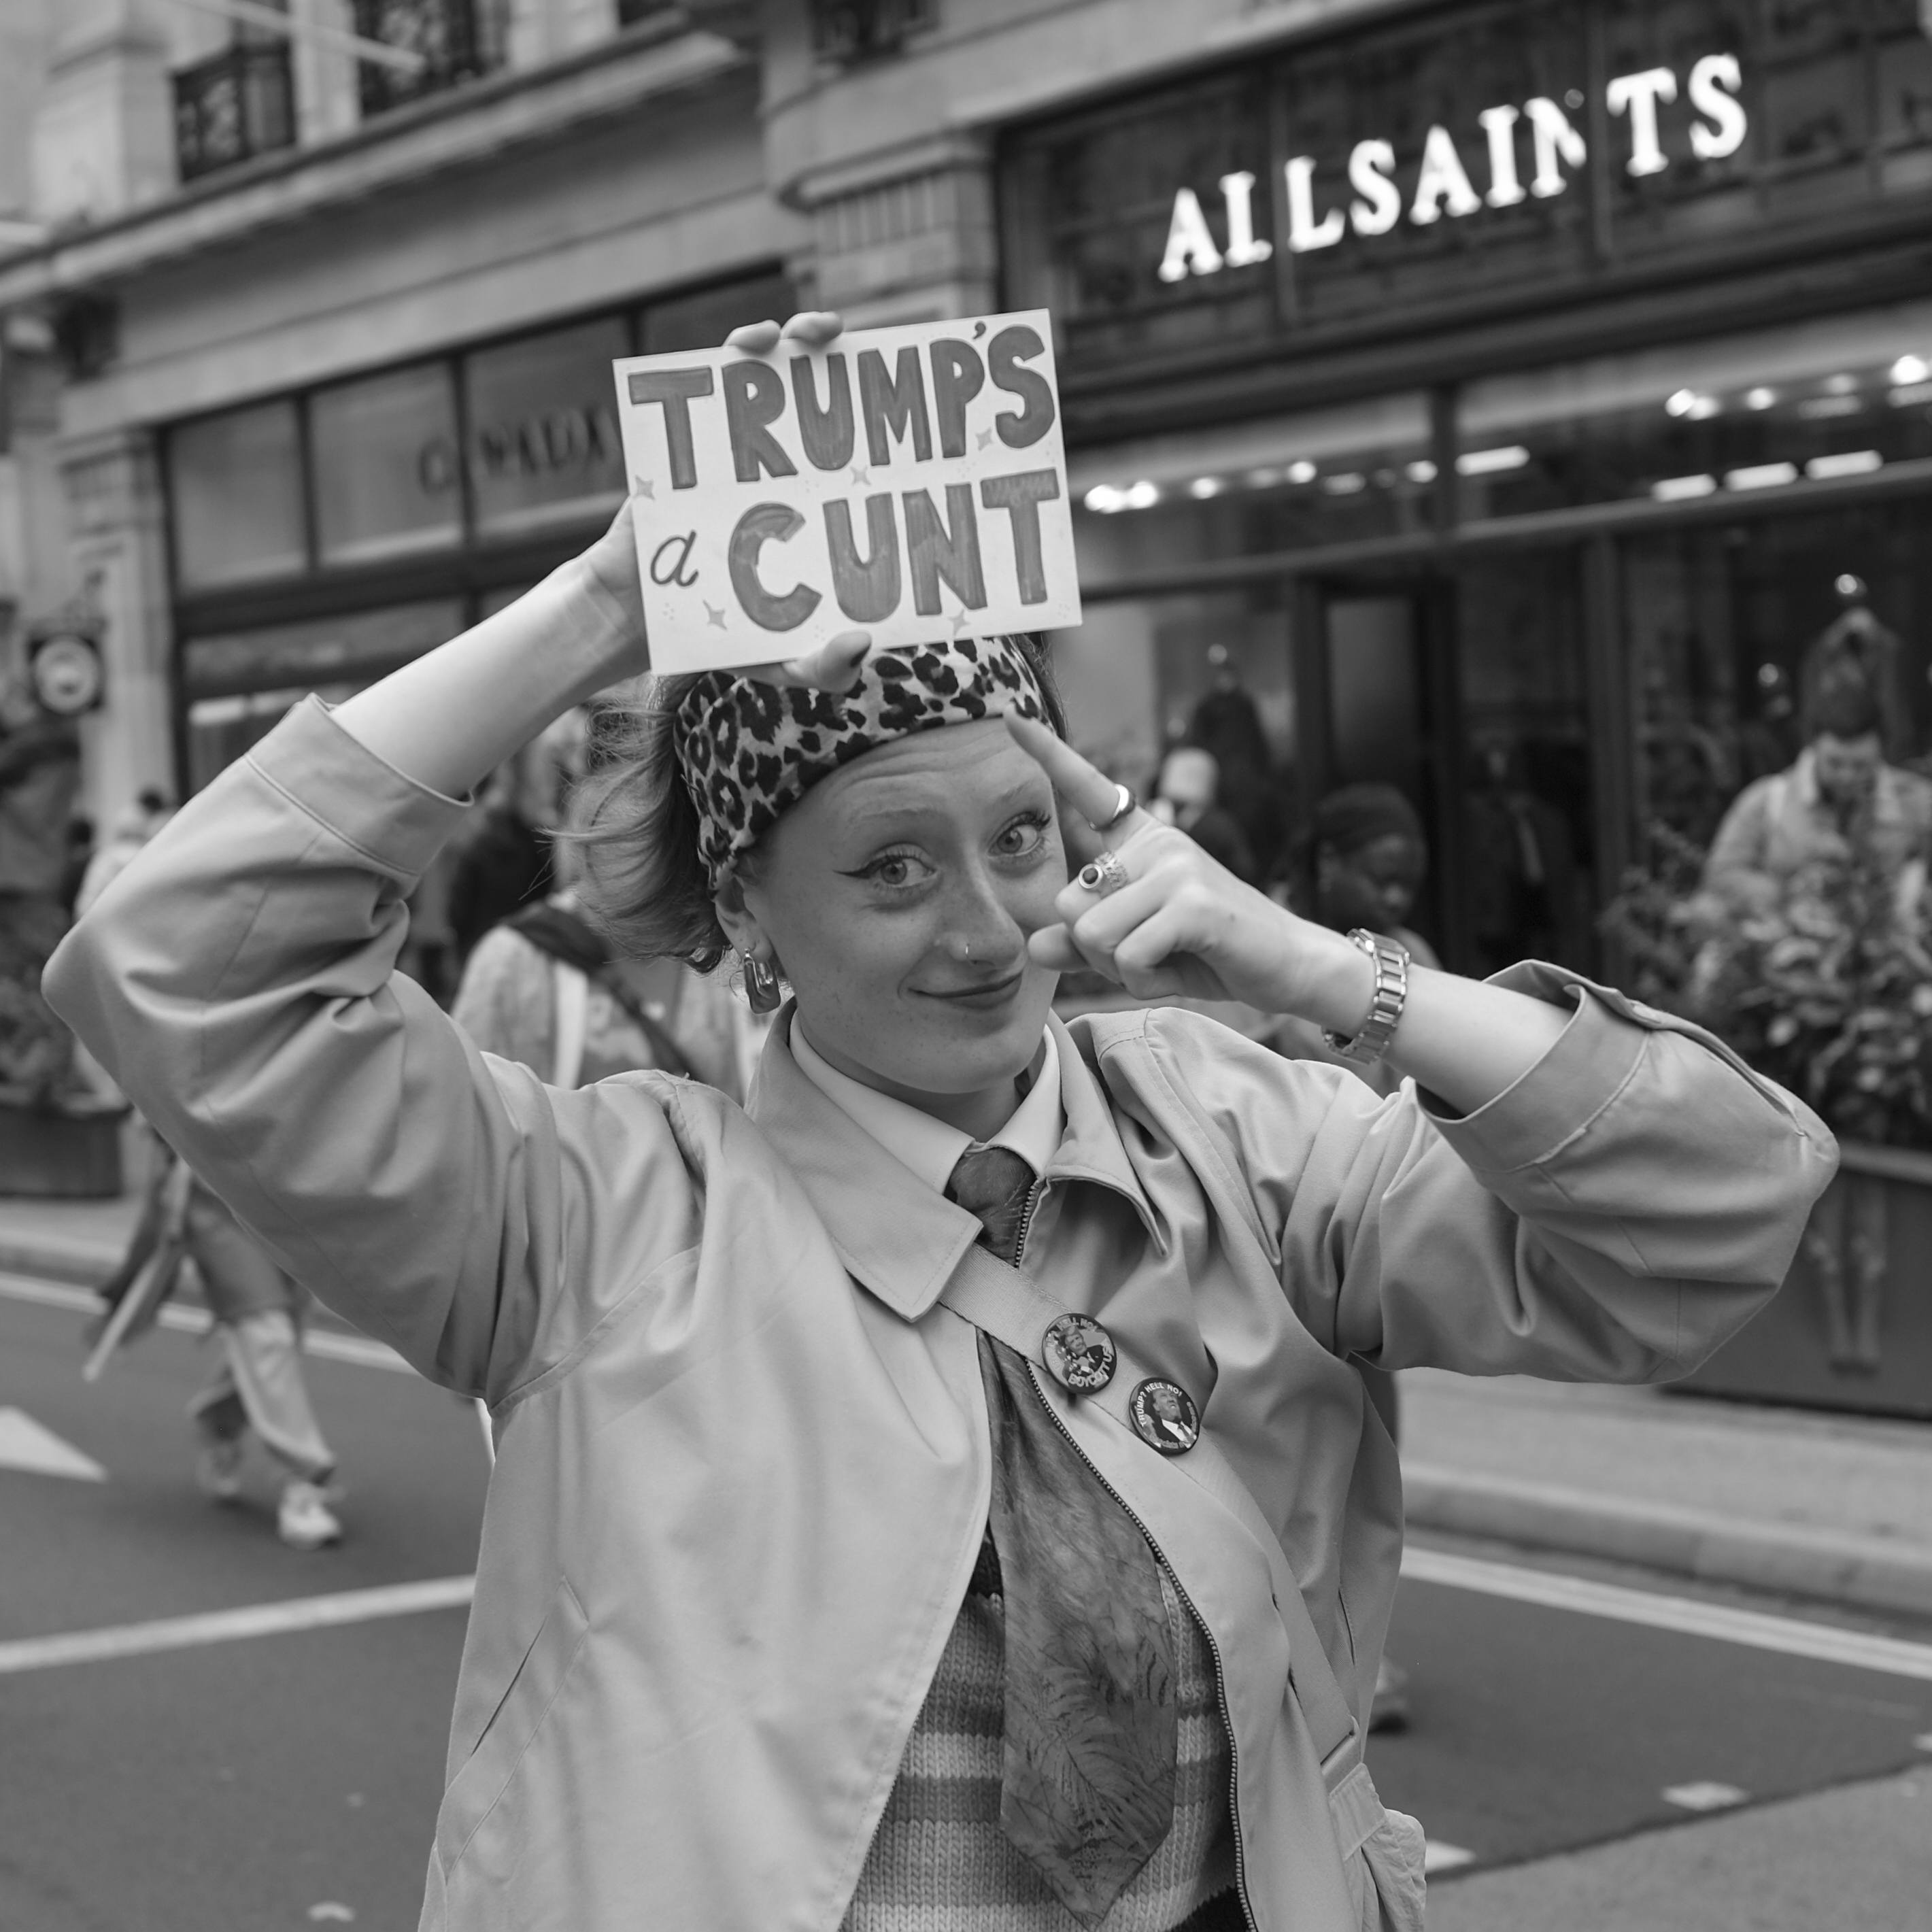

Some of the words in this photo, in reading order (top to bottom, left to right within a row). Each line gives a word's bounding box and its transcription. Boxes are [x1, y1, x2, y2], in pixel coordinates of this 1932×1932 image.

[1158, 52, 1748, 282] ALLSAINTS
[628, 321, 1055, 490] TRUMP'S
[650, 530, 699, 587] a
[728, 468, 1060, 632] CUNT
[1056, 1317, 1079, 1331] HELL
[1068, 1361, 1110, 1387] BOYCOTT
[1136, 1391, 1147, 1427] TRUMP?
[1145, 1382, 1165, 1393] HELL
[1167, 1384, 1183, 1396] NO!
